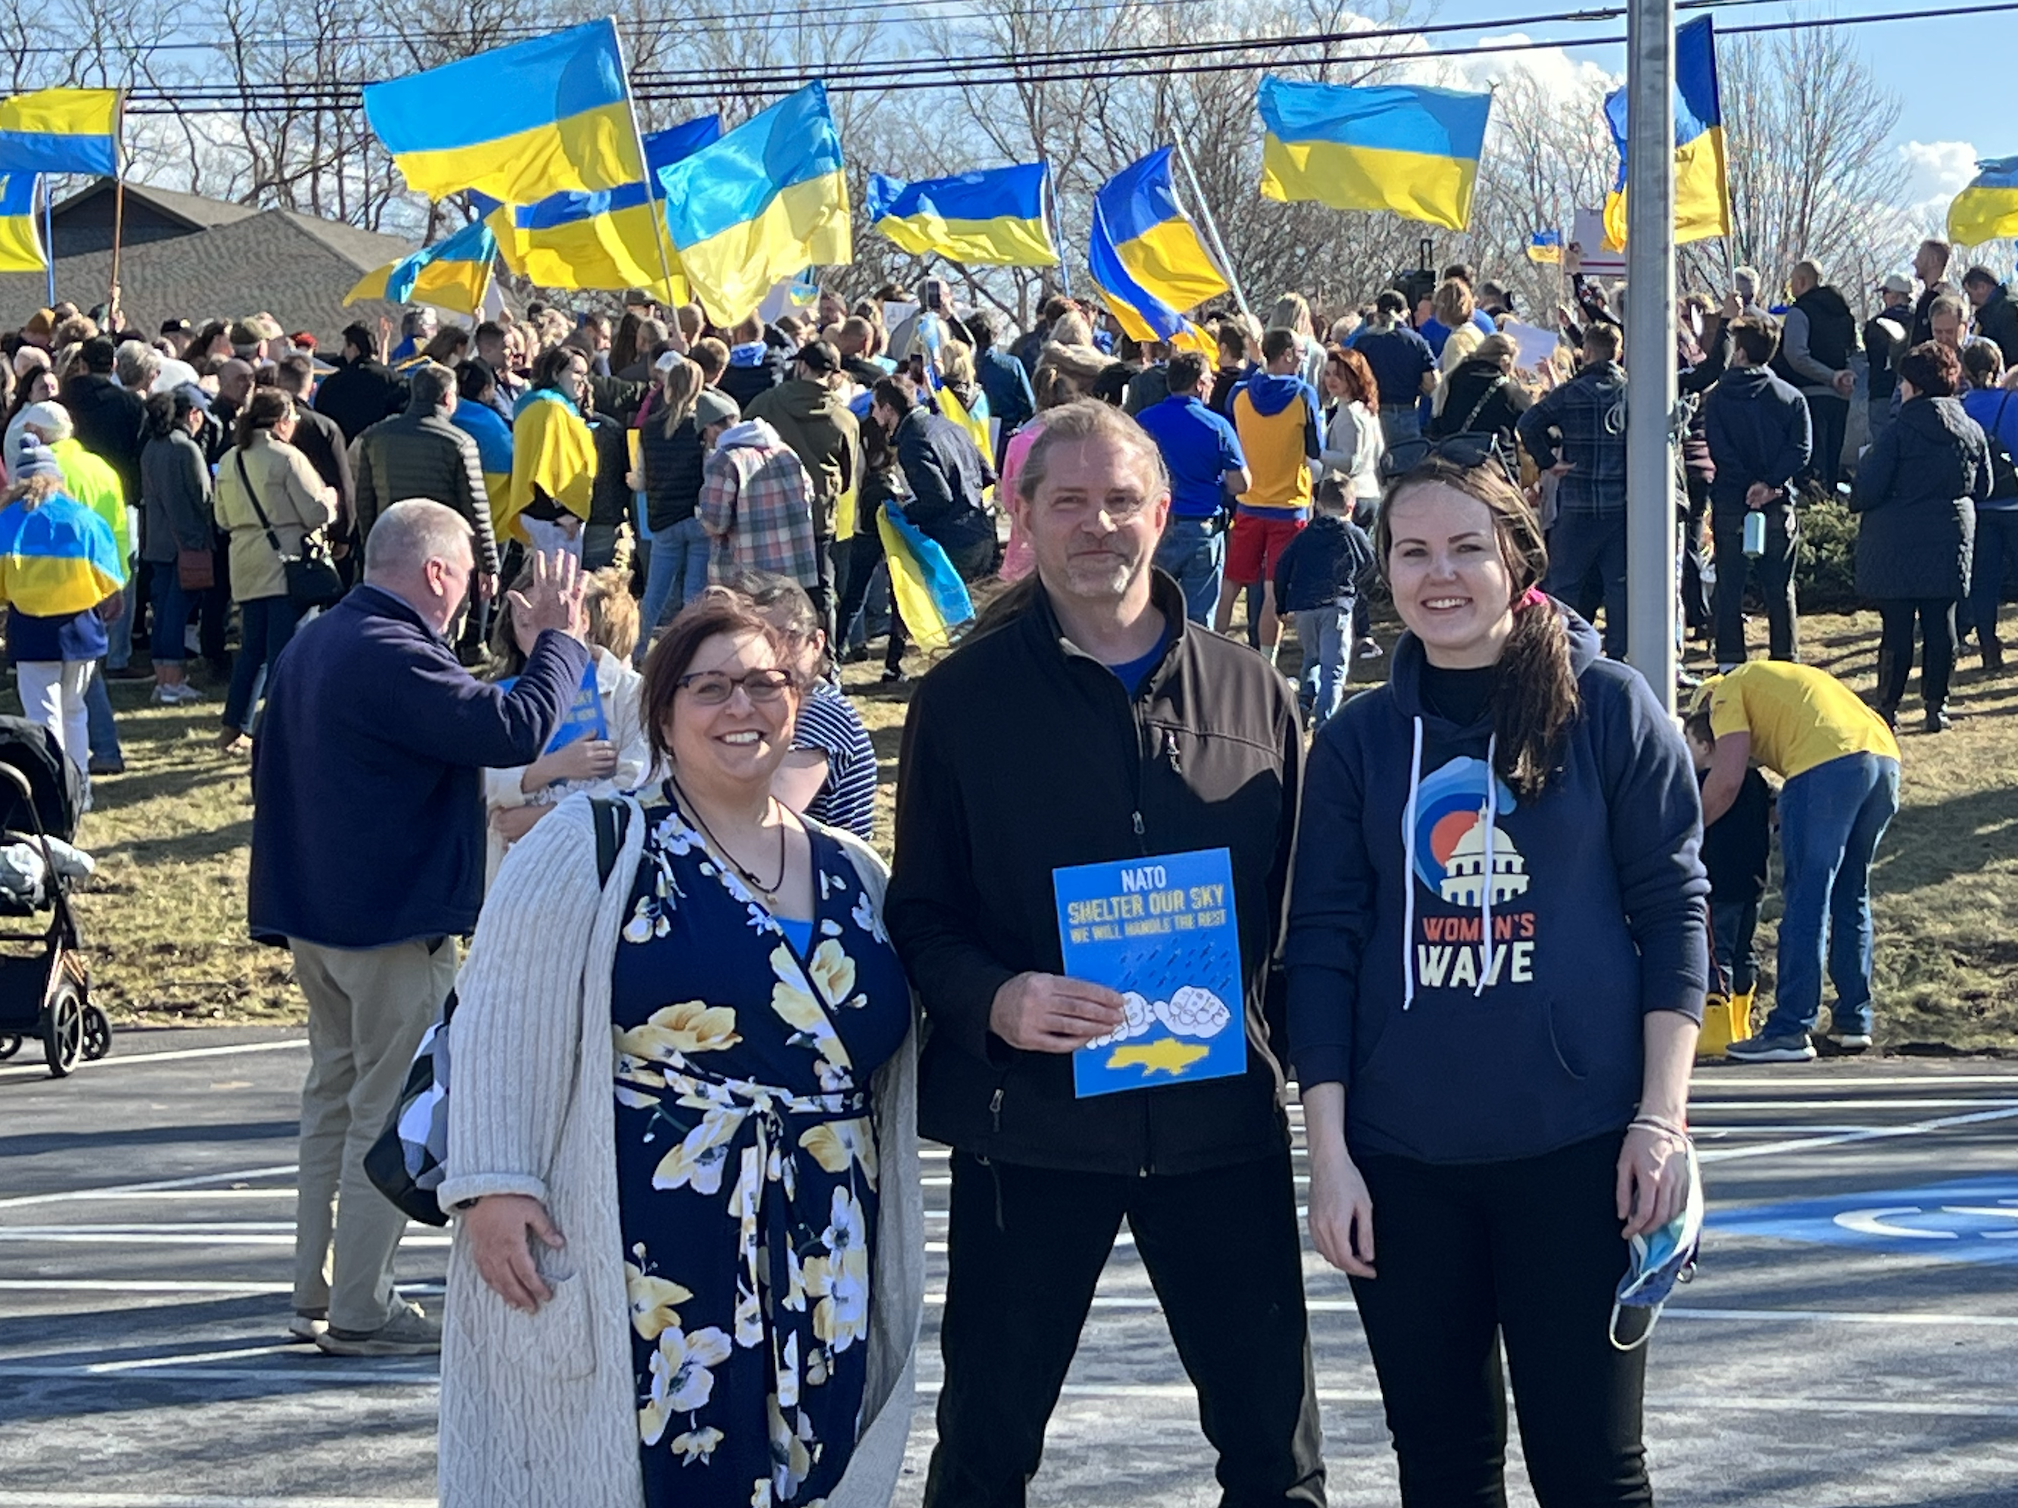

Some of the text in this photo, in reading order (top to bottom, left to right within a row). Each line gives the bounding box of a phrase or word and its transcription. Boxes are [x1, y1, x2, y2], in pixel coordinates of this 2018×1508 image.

[1121, 866, 1166, 893] NATO
[1068, 884, 1224, 924] SHELTER OUR SKY
[1070, 909, 1226, 944] WE WILL HANDLE THE REST
[1422, 913, 1535, 941] WOMN'S
[1418, 941, 1535, 987] WAVE
